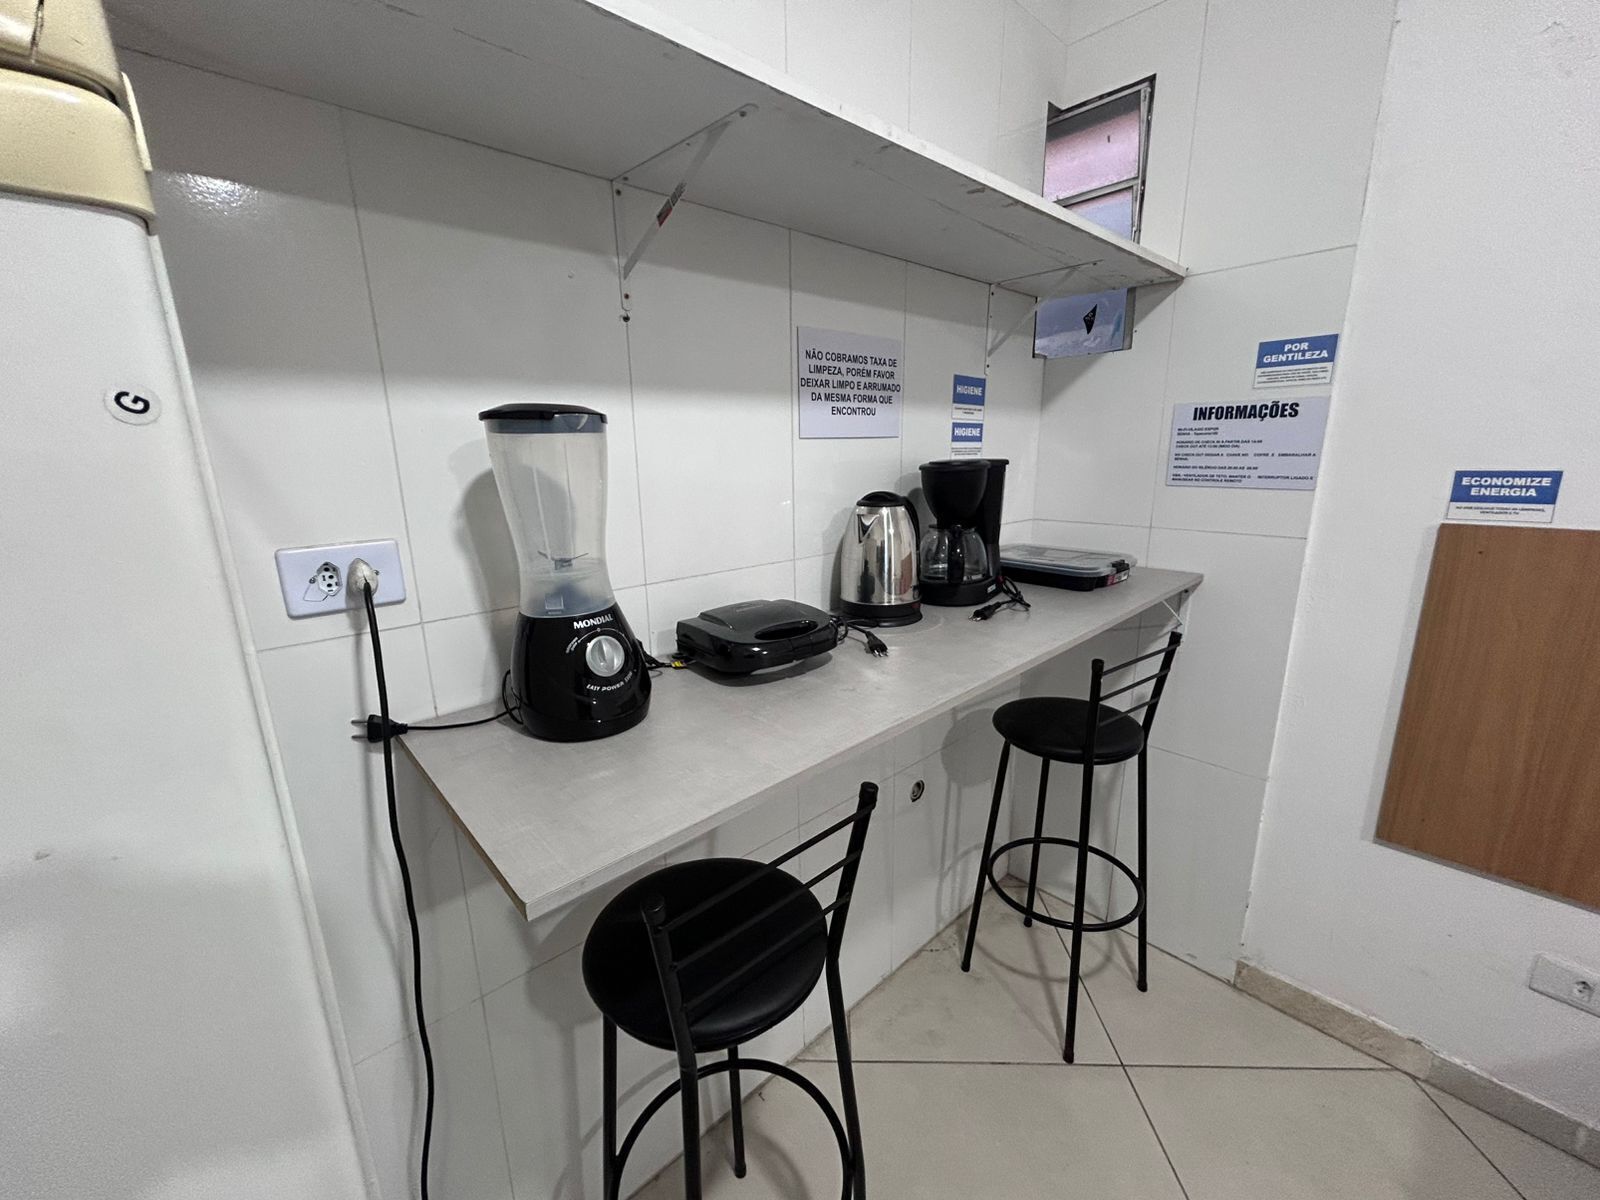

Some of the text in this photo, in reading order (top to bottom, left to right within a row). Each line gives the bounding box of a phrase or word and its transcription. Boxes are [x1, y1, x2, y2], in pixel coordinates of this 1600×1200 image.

[1284, 342, 1309, 352] POR
[805, 348, 898, 368] NÃO COBRAMOS TAXA DE
[1263, 349, 1328, 363] GENTILEZA
[808, 364, 895, 380] LIMPEZA, PORÉM FAVOR
[800, 377, 901, 393] DEIXAR LIMPO E ARRUMADO
[956, 384, 983, 396] HIGIENE
[114, 391, 150, 415] G
[811, 391, 893, 404] DA MESMA FORMA QUE
[831, 406, 876, 416] ENCONTROU
[1192, 400, 1300, 422] INFORMAÇÕES
[954, 426, 981, 437] HIGIENE
[1461, 476, 1553, 486] ECONOMIZE
[1470, 487, 1537, 497] ENERGIA
[573, 613, 613, 630] MONDIAL
[586, 681, 624, 692] EASY POWER
